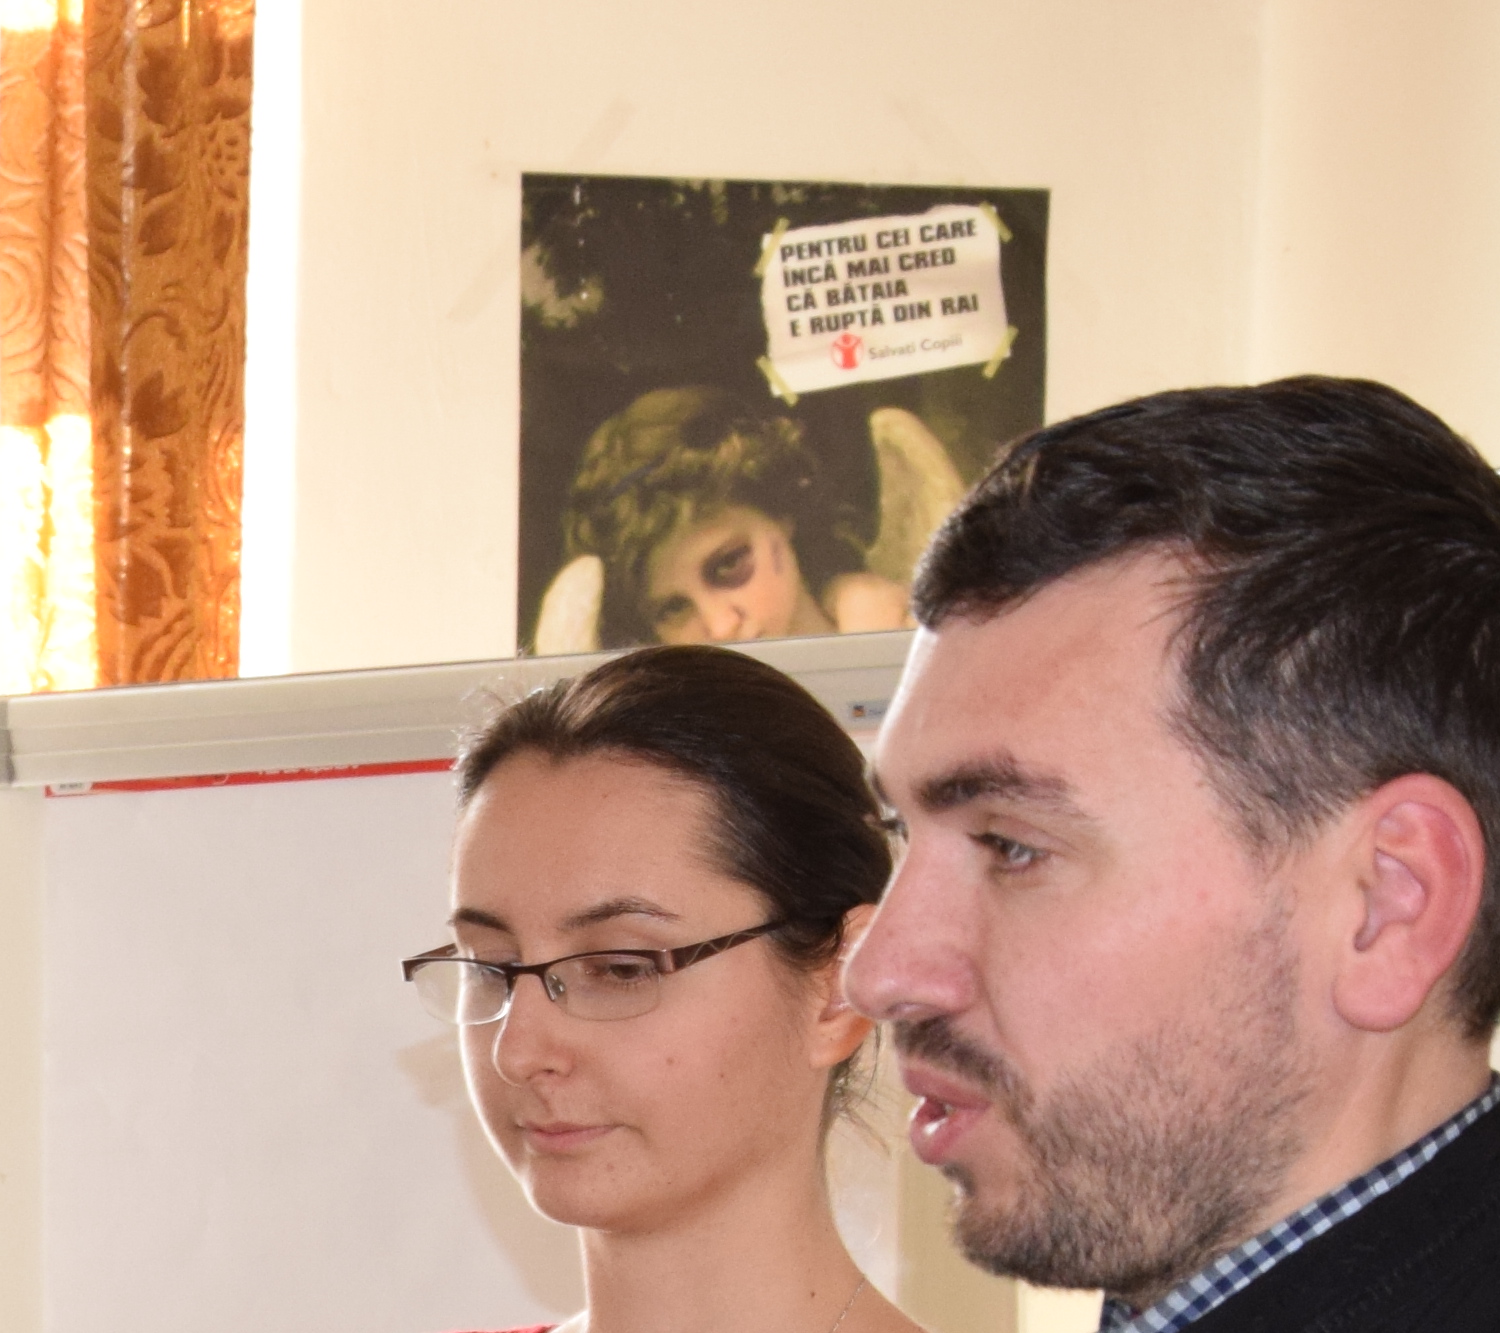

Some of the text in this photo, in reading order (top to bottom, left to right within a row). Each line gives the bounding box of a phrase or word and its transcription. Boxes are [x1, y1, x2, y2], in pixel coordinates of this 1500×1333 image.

[780, 218, 976, 262] PENTRU CEI CARE
[847, 256, 890, 279] MAI
[898, 247, 956, 271] CRED
[786, 279, 909, 312] CĂ BĂTAIA
[790, 294, 979, 337] E RUPTĂ DIN RAI
